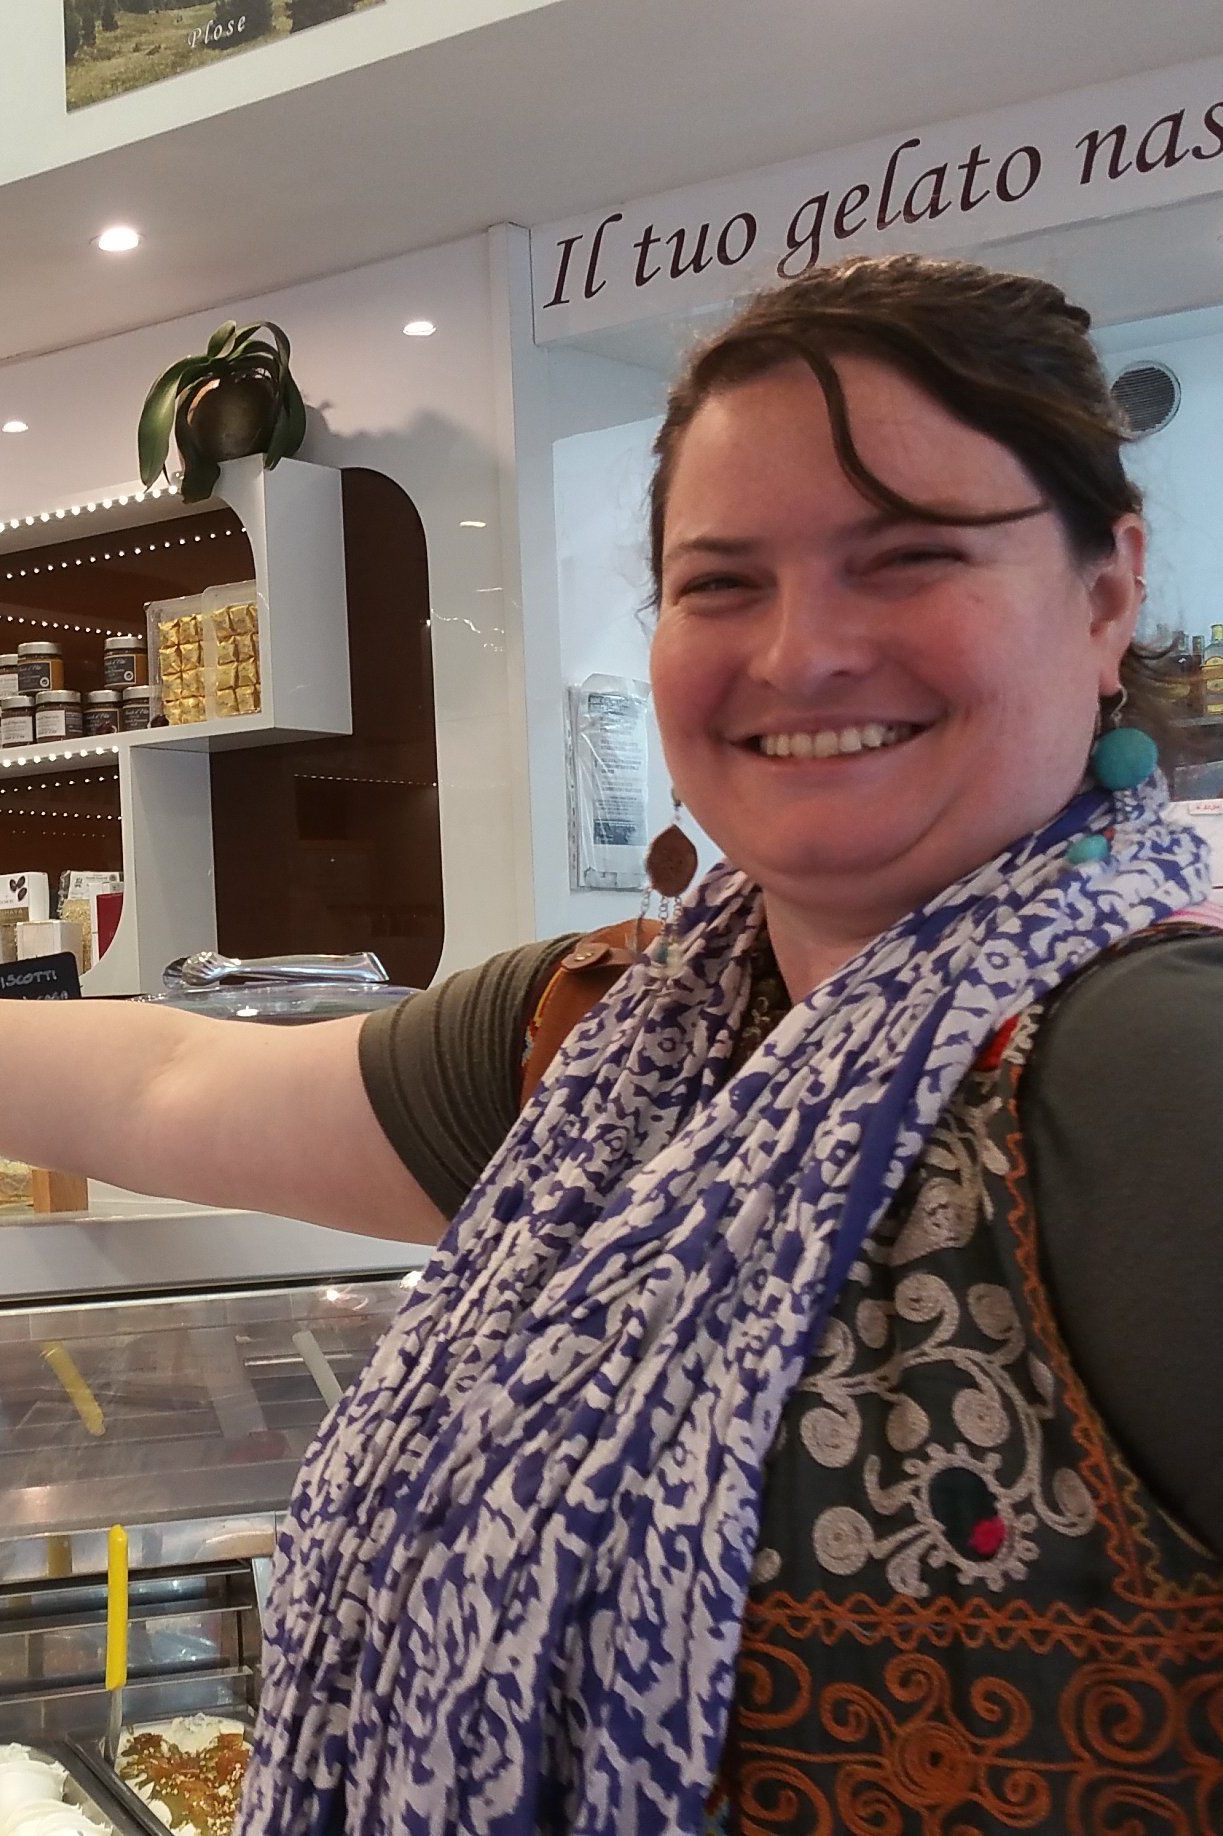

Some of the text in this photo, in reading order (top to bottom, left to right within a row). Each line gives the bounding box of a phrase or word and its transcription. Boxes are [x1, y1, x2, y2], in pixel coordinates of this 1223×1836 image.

[187, 15, 247, 48] Plose
[543, 213, 622, 309] Il
[633, 212, 757, 287] tuo
[777, 138, 1041, 279] gelato
